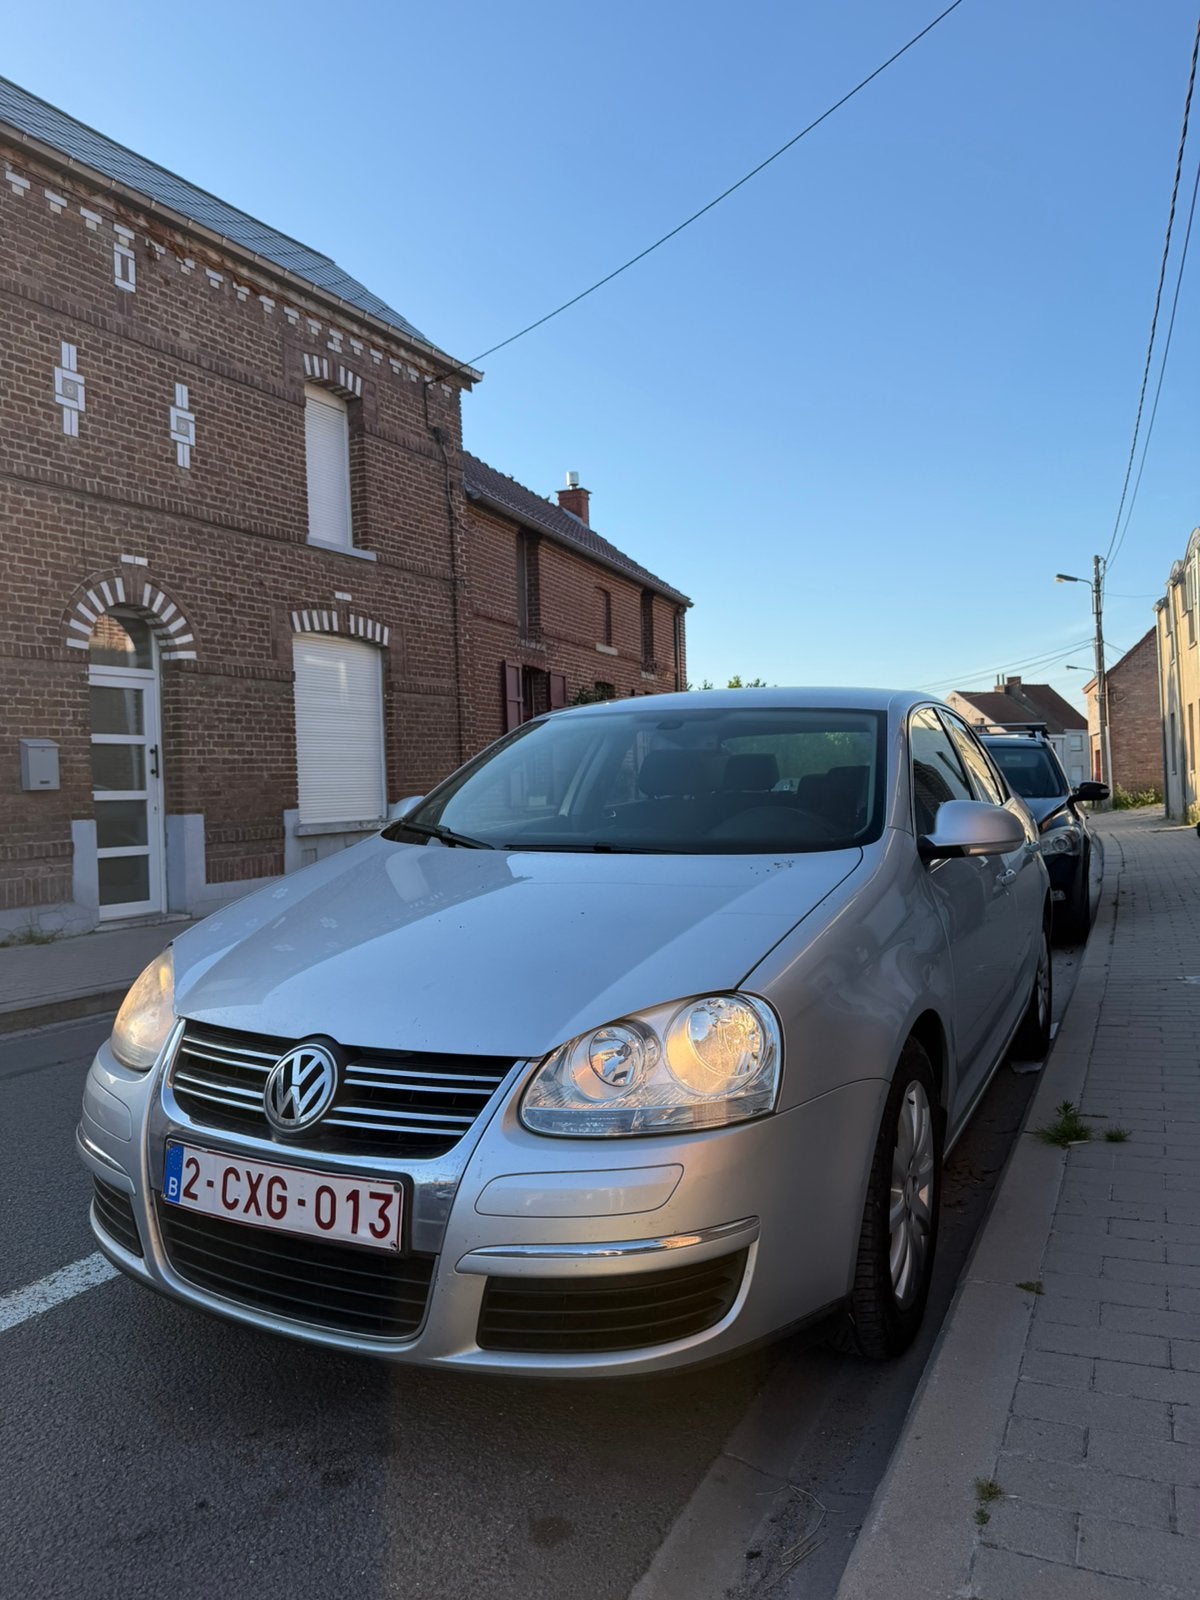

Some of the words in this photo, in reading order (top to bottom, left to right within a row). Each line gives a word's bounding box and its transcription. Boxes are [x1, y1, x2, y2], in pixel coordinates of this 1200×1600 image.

[268, 1047, 333, 1125] VW
[168, 1176, 178, 1197] B
[182, 1156, 394, 1239] 2-CXG-013
